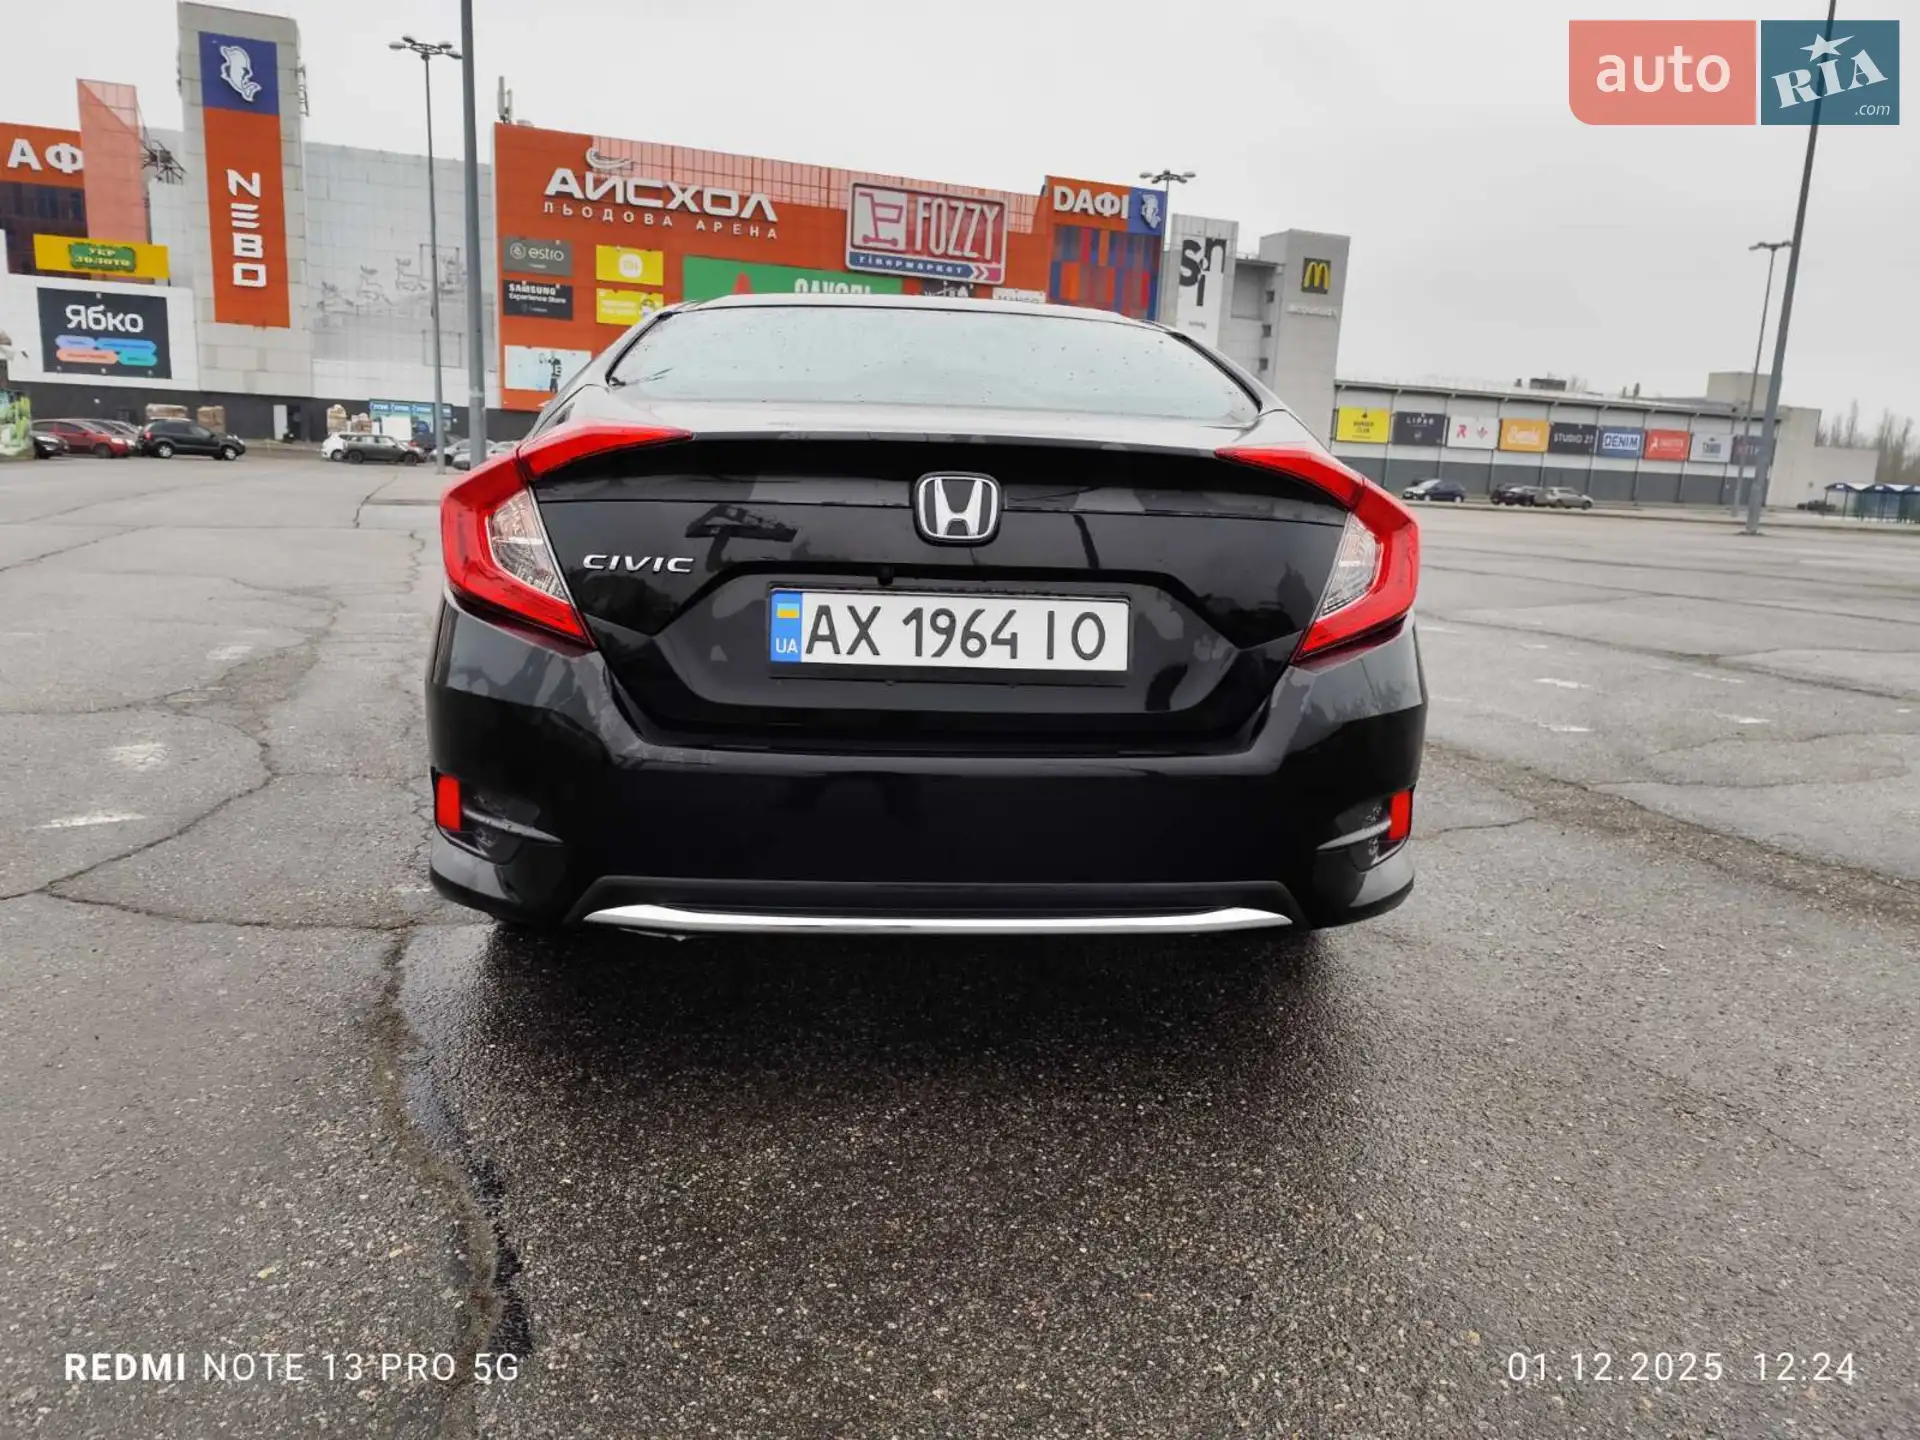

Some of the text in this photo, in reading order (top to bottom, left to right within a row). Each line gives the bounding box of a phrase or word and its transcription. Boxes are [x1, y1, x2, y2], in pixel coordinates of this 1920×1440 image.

[696, 220, 778, 239] АРЕНА
[916, 196, 1000, 261] FOZZY
[528, 246, 565, 262] estro
[508, 283, 557, 296] SAMSUNG
[65, 304, 144, 333] Ябко
[582, 553, 695, 574] CIVIC
[805, 604, 1107, 662] AX 1964 IO
[775, 638, 799, 655] UA
